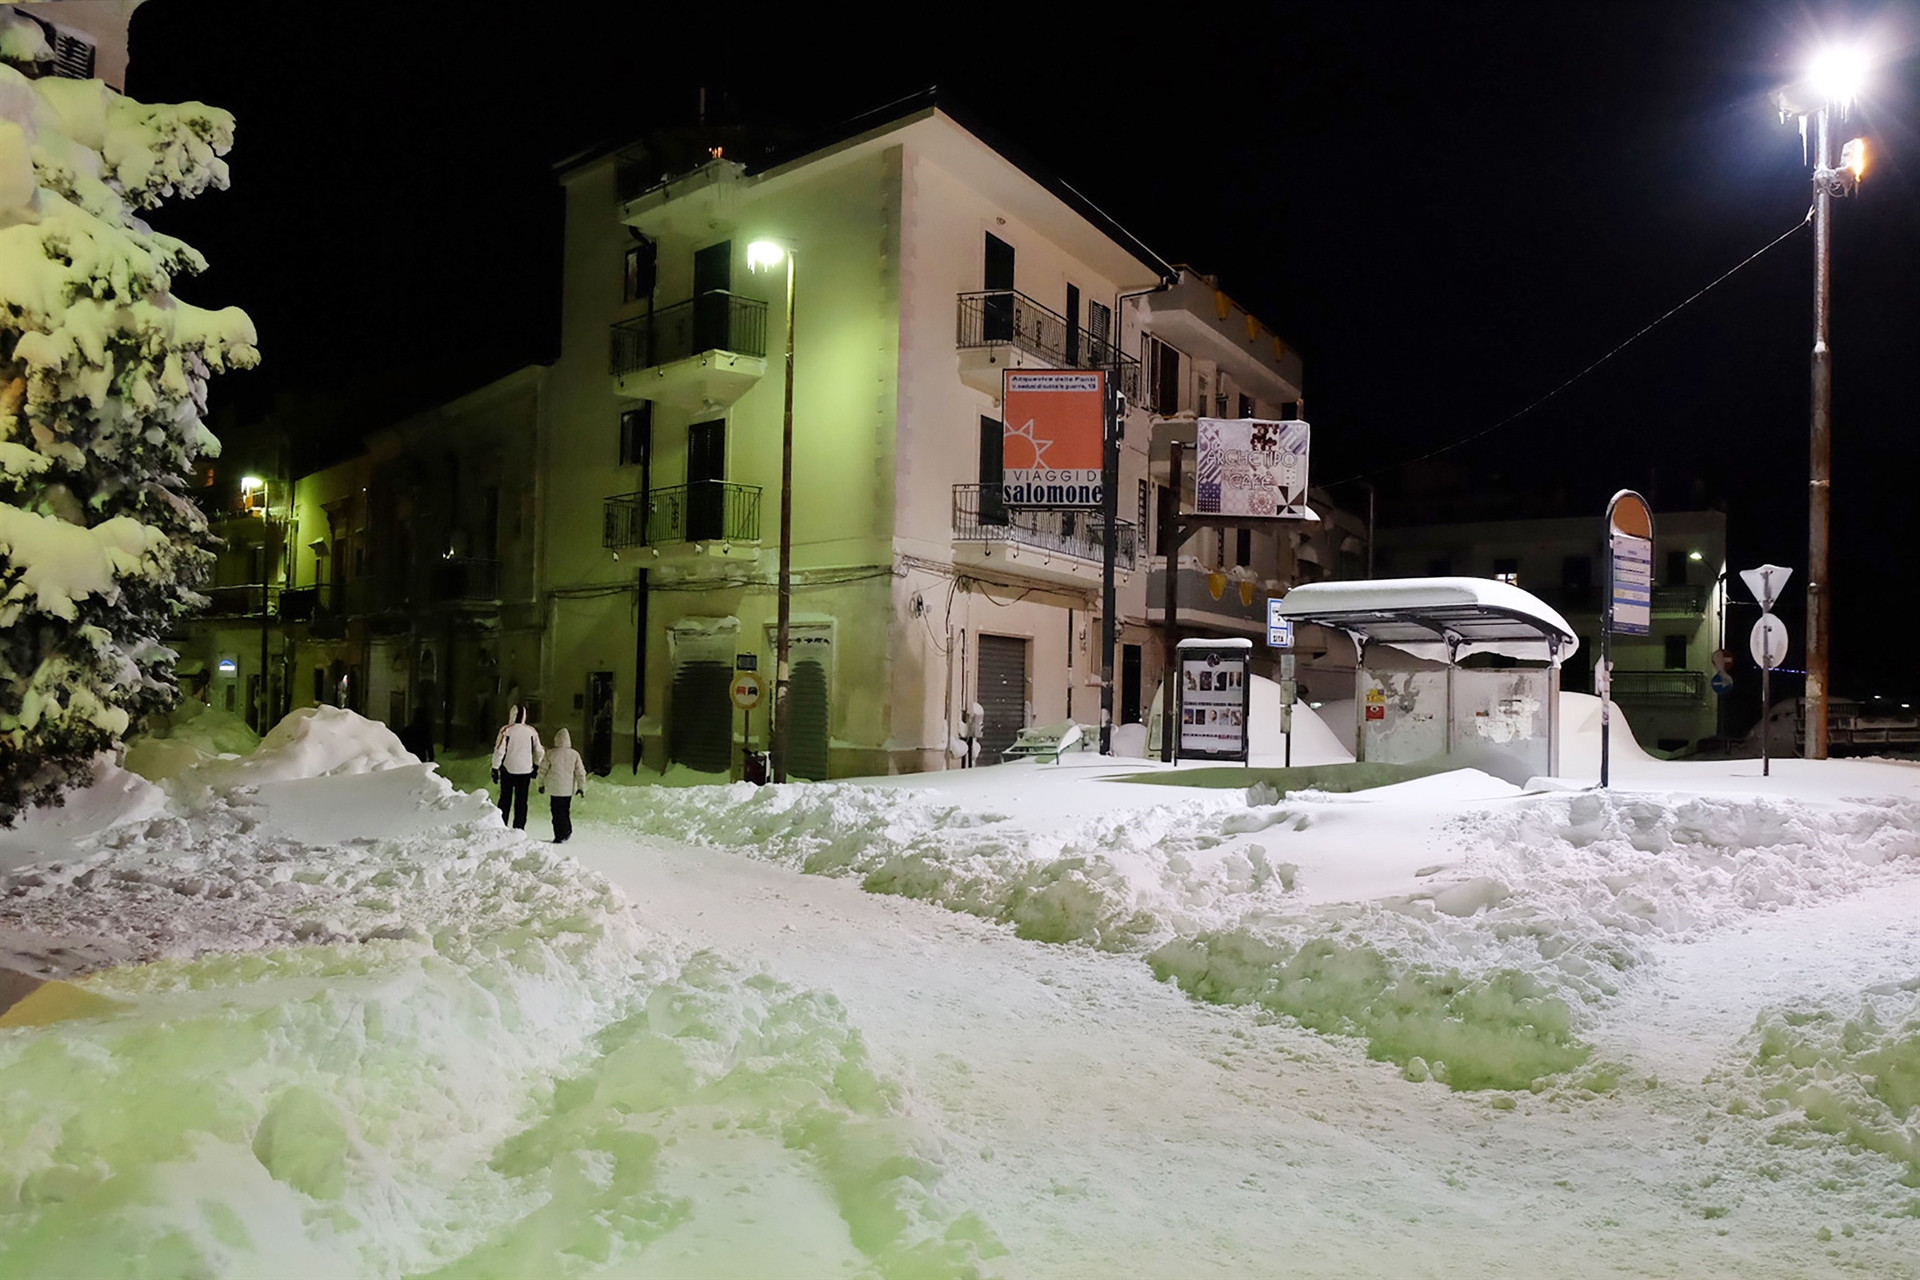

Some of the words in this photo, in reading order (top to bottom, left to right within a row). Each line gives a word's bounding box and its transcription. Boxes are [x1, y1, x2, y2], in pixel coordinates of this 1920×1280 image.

[1206, 449, 1298, 468] ARCHETIPO
[1013, 470, 1079, 482] VIAGGI
[1003, 482, 1103, 503] salomone
